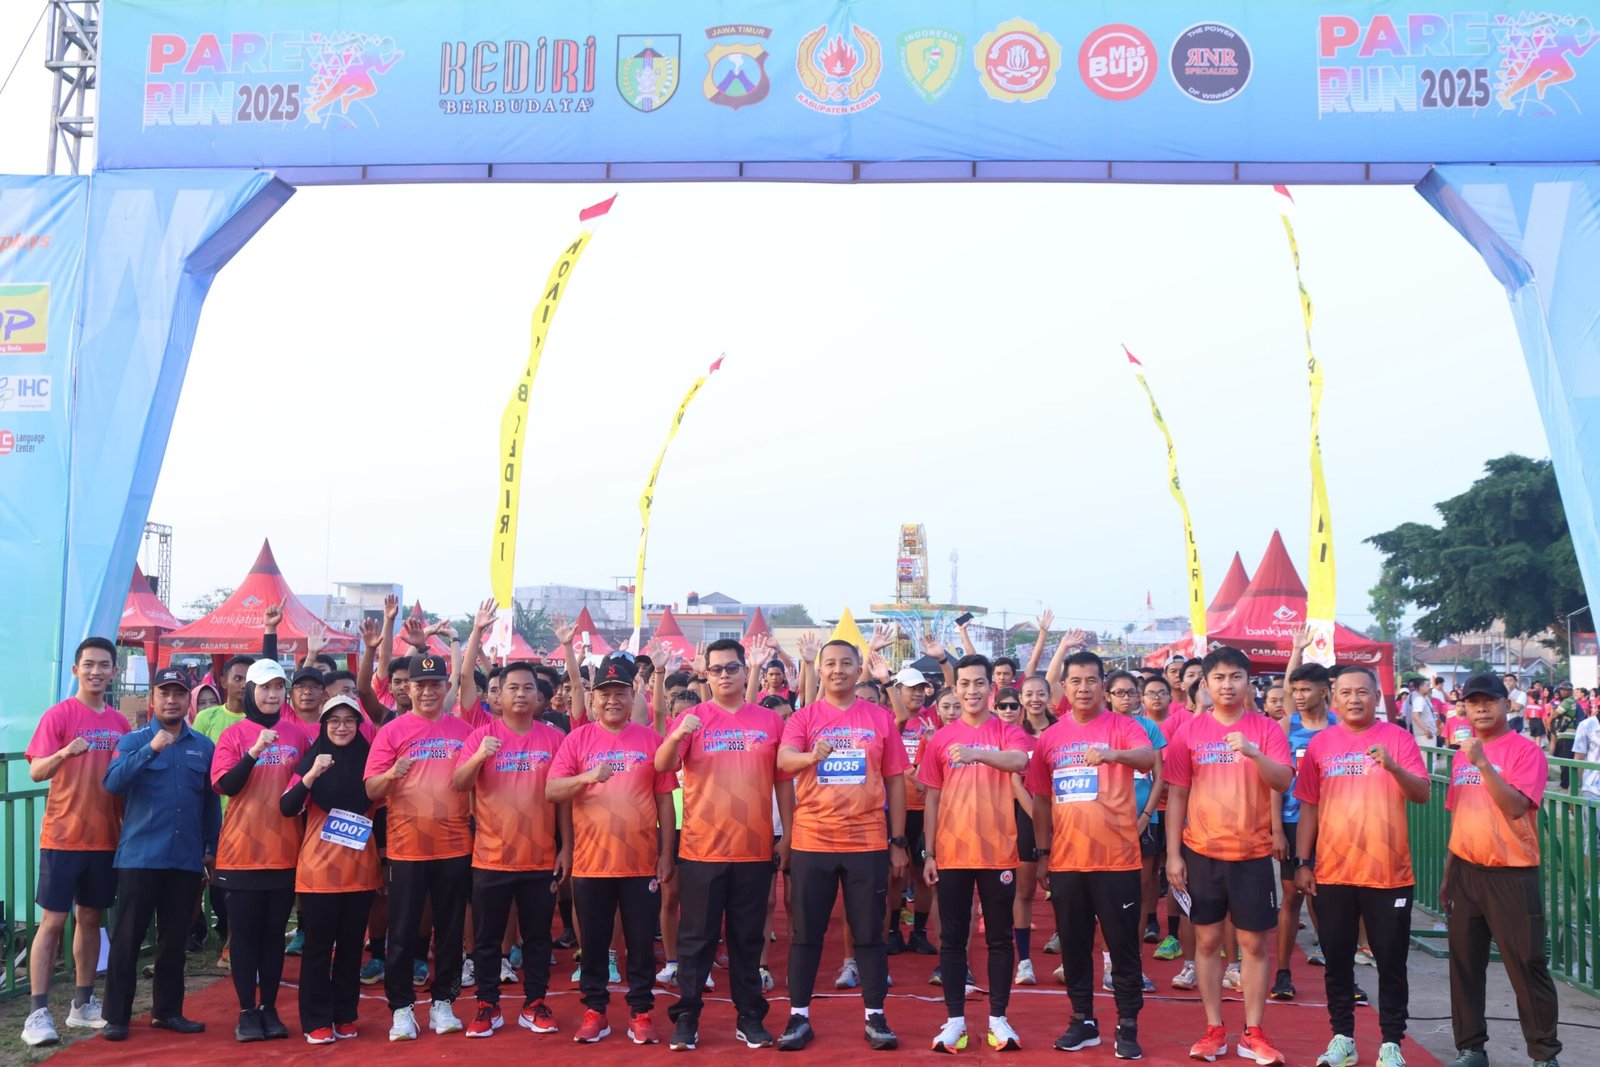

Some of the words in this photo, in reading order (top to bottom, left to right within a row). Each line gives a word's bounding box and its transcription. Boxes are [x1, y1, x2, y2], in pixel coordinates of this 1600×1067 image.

[712, 26, 736, 37] JAWA
[738, 25, 766, 37] TIMUR
[904, 29, 958, 42] INDONESIA
[1187, 27, 1203, 38] THE
[1204, 25, 1236, 39] POWER
[1318, 12, 1491, 58] PARE
[148, 30, 305, 75] PARE
[1109, 45, 1146, 60] Mas
[1089, 56, 1144, 78] Bup
[1184, 67, 1239, 75] SPECIALIZED
[1188, 86, 1201, 98] OF
[1201, 87, 1236, 100] WINNER
[1318, 66, 1418, 112] RUN
[1420, 67, 1491, 108] 2025
[145, 81, 235, 126] RUN
[236, 82, 301, 122] 2025
[440, 98, 594, 114] BERBUDAYA
[797, 92, 848, 113] KABUPATEN
[850, 93, 879, 112] KEDIRI
[18, 378, 49, 397] IHC
[16, 434, 45, 443] Language
[16, 443, 35, 453] Center
[210, 614, 263, 627] bankjatim
[1250, 648, 1292, 657] CABANG
[1337, 651, 1373, 662] bankjatim
[703, 729, 744, 739] PARE
[703, 740, 728, 752] RUN
[728, 740, 745, 751] 2025
[833, 738, 851, 749] 2025
[430, 749, 447, 759] 2025
[586, 750, 625, 761] PARE
[1324, 751, 1364, 764] PARE
[823, 760, 860, 772] 0035
[1345, 764, 1363, 775] 2025
[1059, 777, 1091, 791] 0041
[330, 820, 367, 837] 0007
